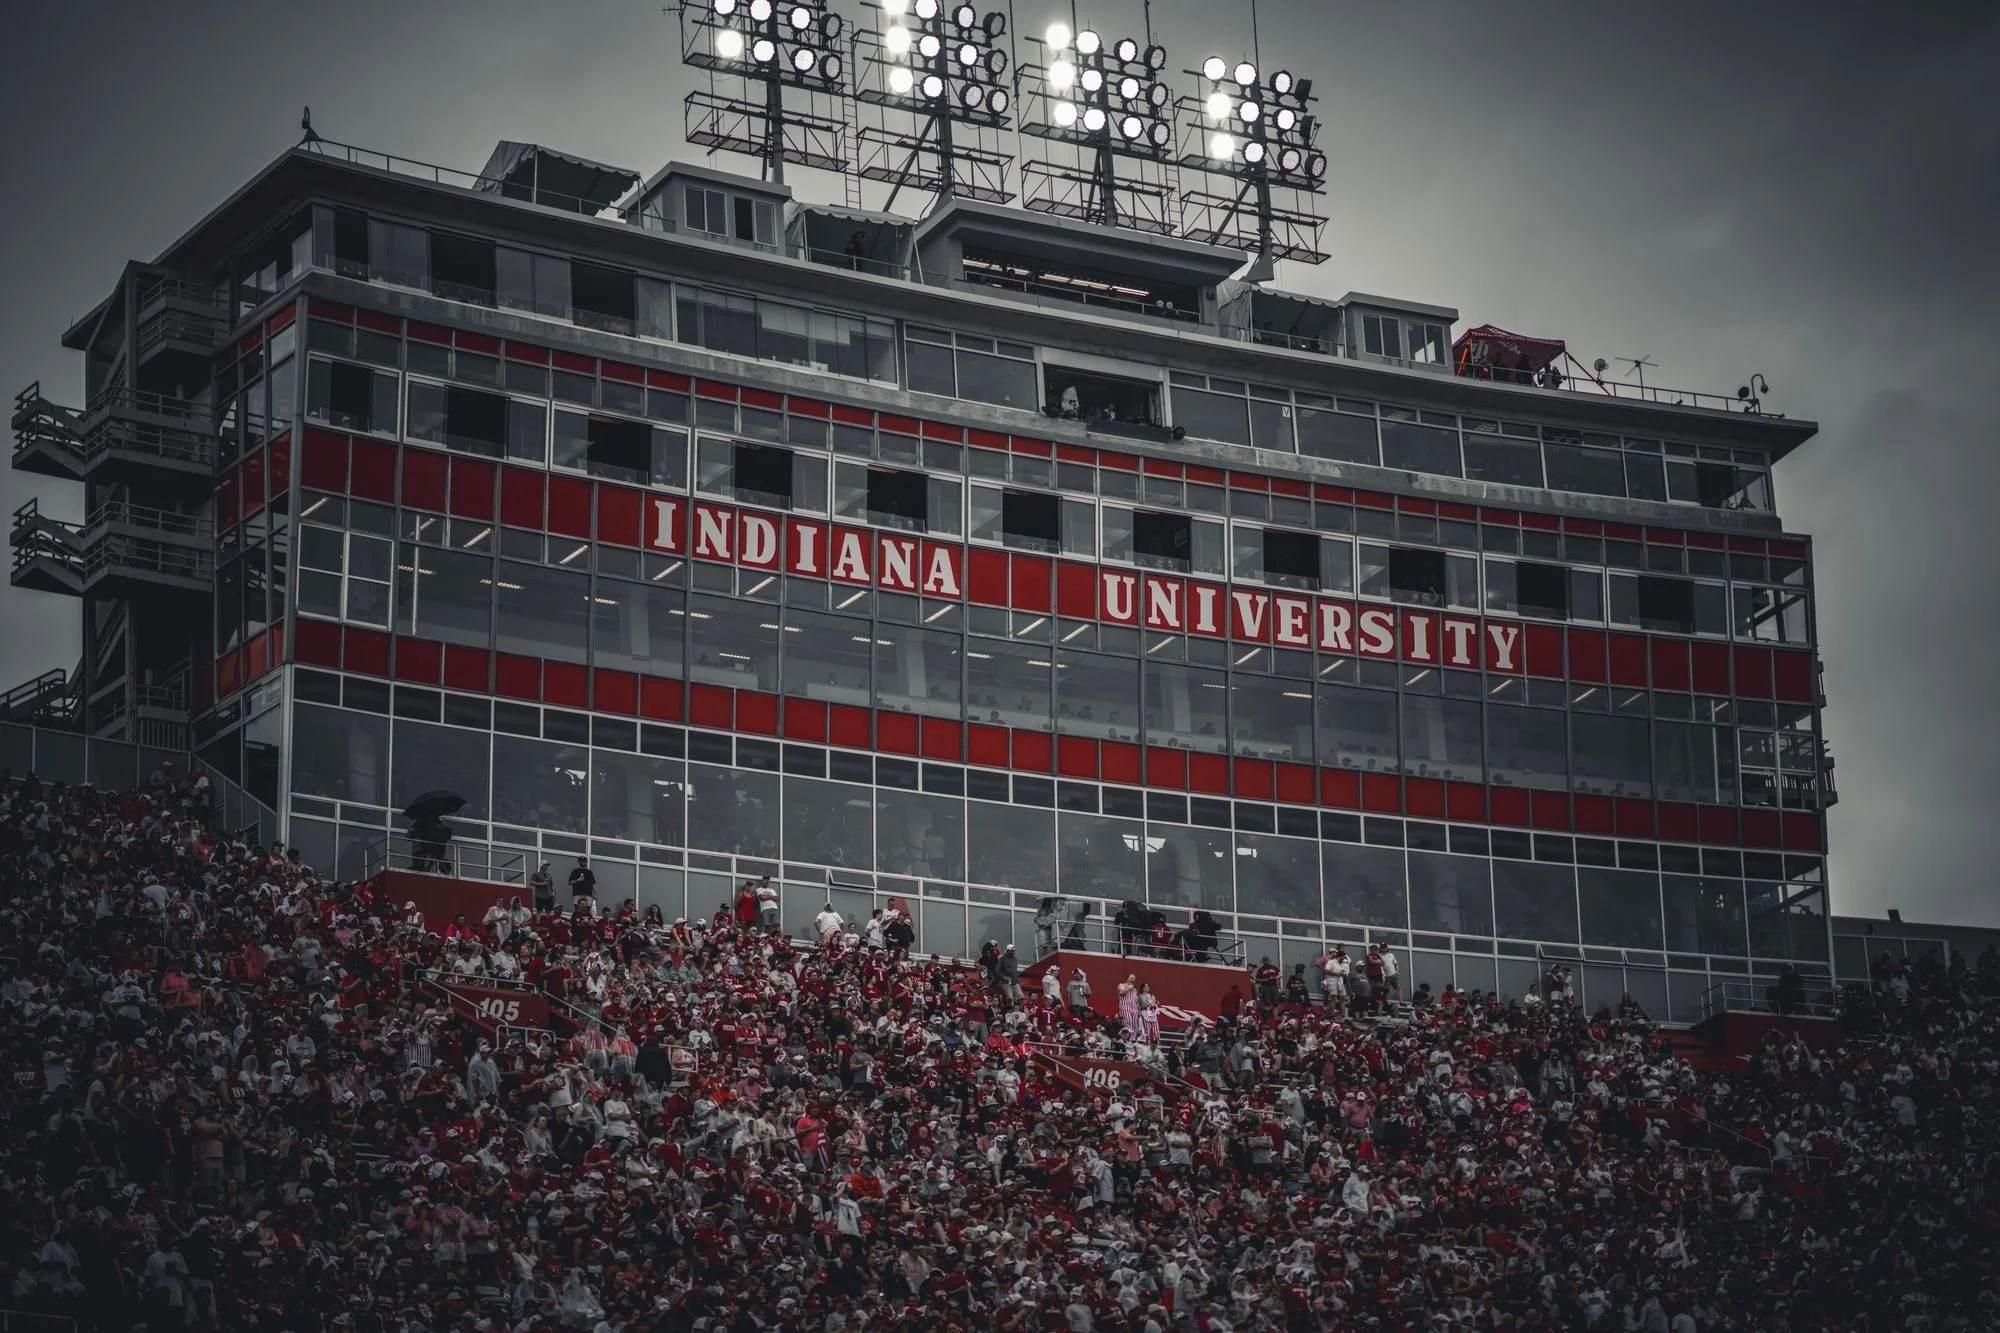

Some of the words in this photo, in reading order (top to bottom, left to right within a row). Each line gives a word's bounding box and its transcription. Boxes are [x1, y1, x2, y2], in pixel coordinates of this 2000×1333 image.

[1527, 337, 1564, 347] MANAGEMENT
[653, 500, 960, 596] INDIANA
[1102, 573, 1518, 670] UNIVERSITY
[480, 998, 520, 1021] 105
[1084, 1067, 1121, 1089] 106
